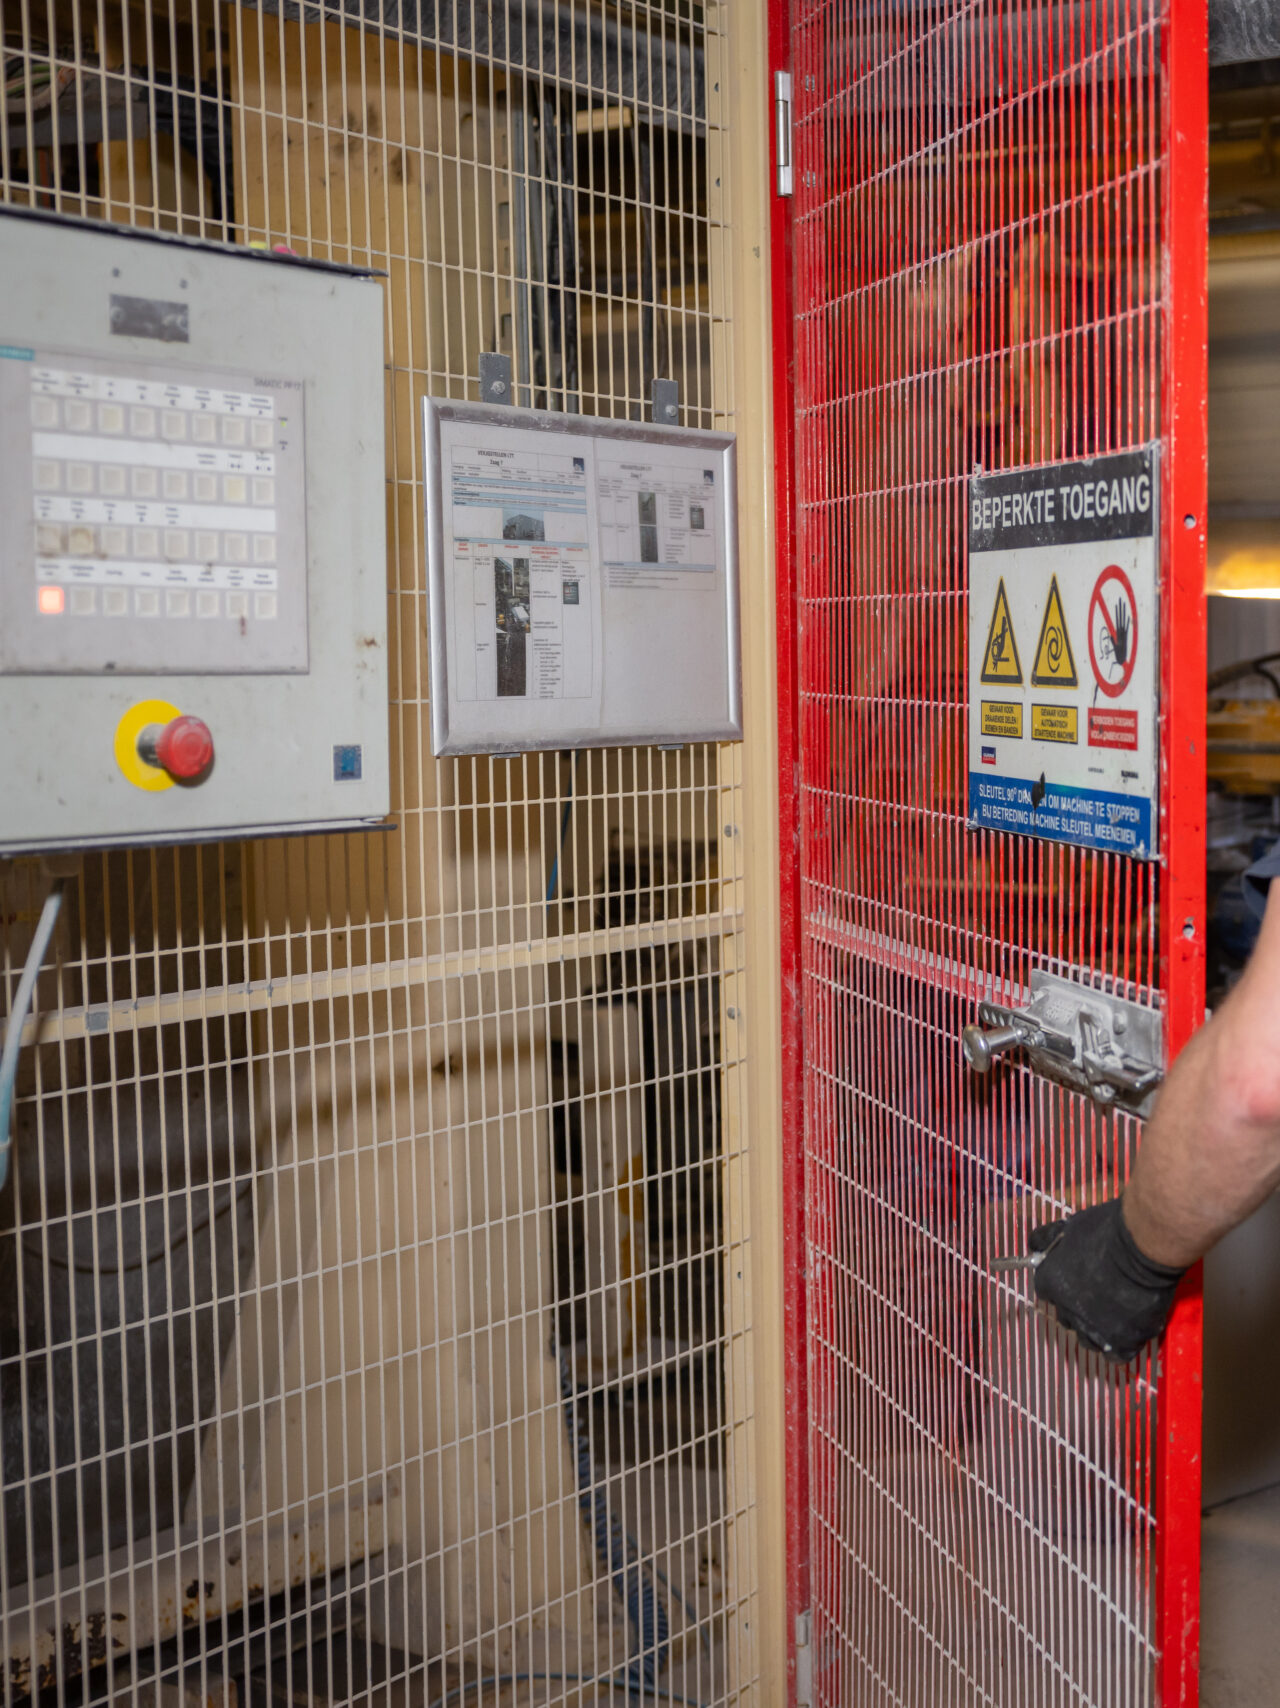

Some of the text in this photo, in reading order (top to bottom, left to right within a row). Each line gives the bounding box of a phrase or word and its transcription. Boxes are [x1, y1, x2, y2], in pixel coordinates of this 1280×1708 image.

[972, 474, 1150, 531] BEPERKTE TOEGANG
[979, 783, 1006, 801] SLEUTEL
[1048, 794, 1060, 809] OM
[1060, 796, 1094, 816] MACHINE
[1095, 800, 1105, 817] TE
[1106, 803, 1140, 824] STOPPEN
[982, 803, 1137, 845] BIJ BETREDING MACHINE SLEUTEL MEENEMEN
